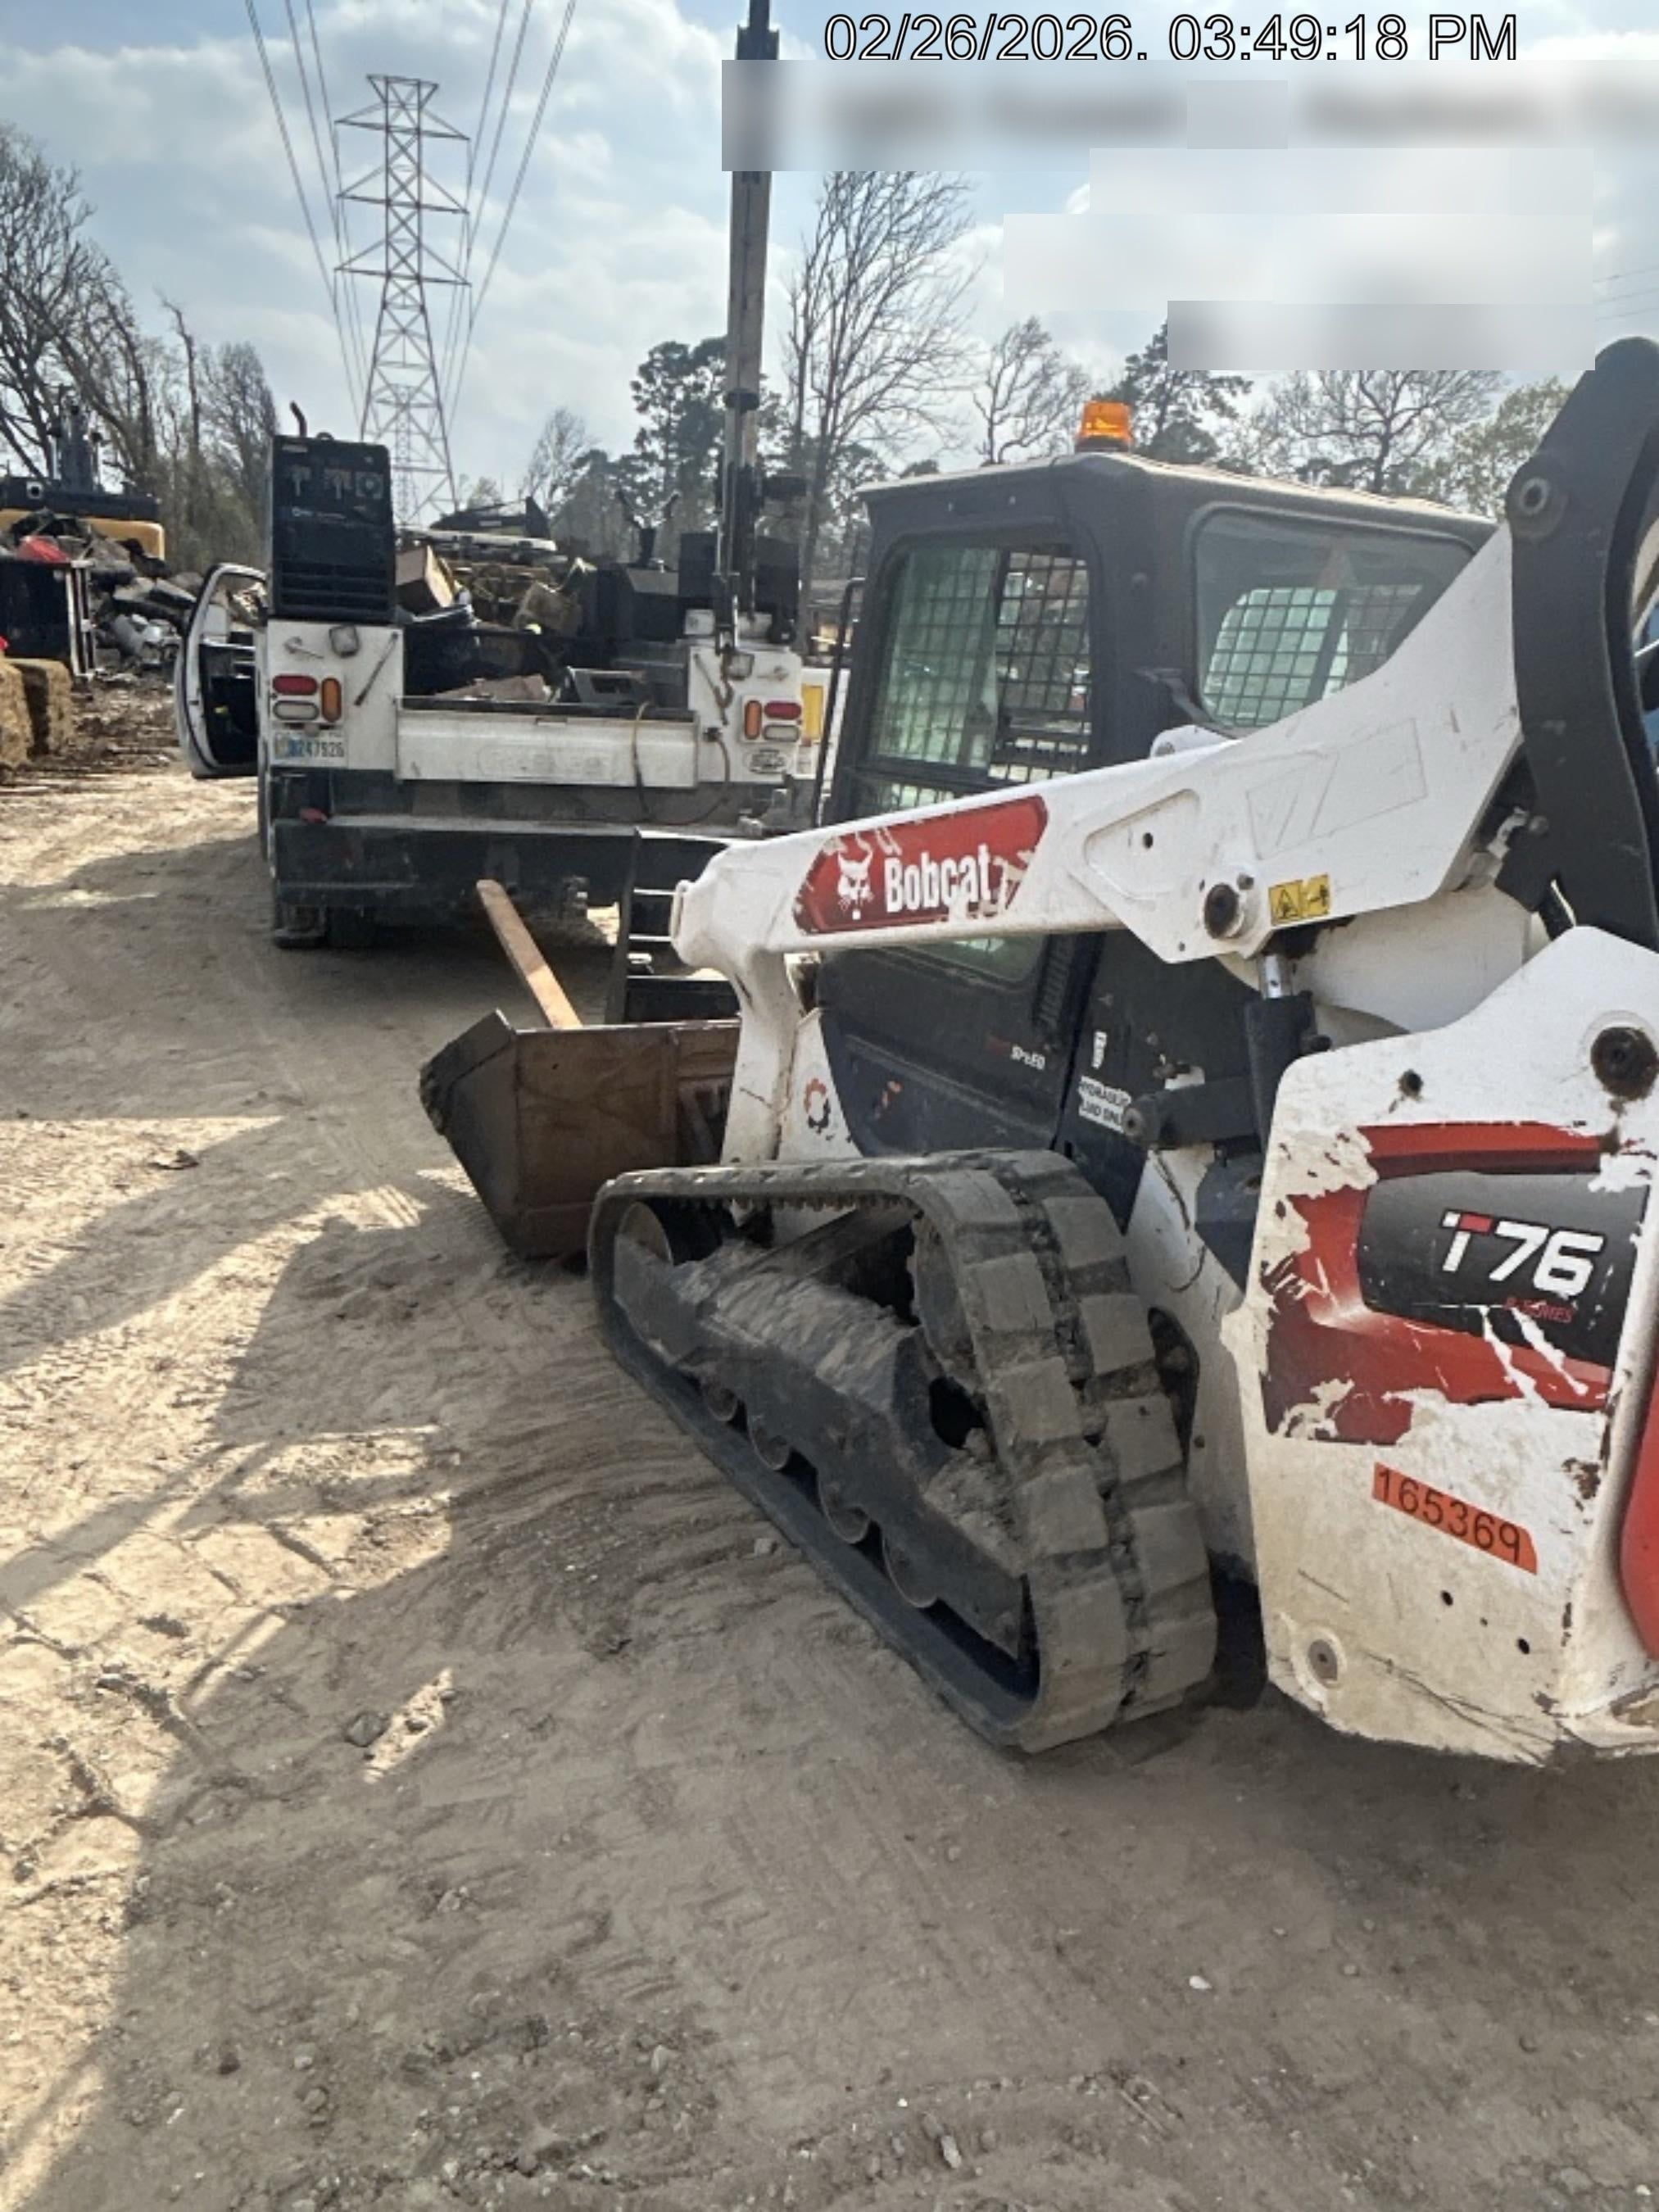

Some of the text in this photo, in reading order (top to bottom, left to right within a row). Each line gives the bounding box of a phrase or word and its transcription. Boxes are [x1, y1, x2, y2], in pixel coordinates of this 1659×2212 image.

[885, 844, 991, 913] Bobcat
[1442, 1211, 1605, 1298] T76
[1379, 1469, 1521, 1565] 165369
